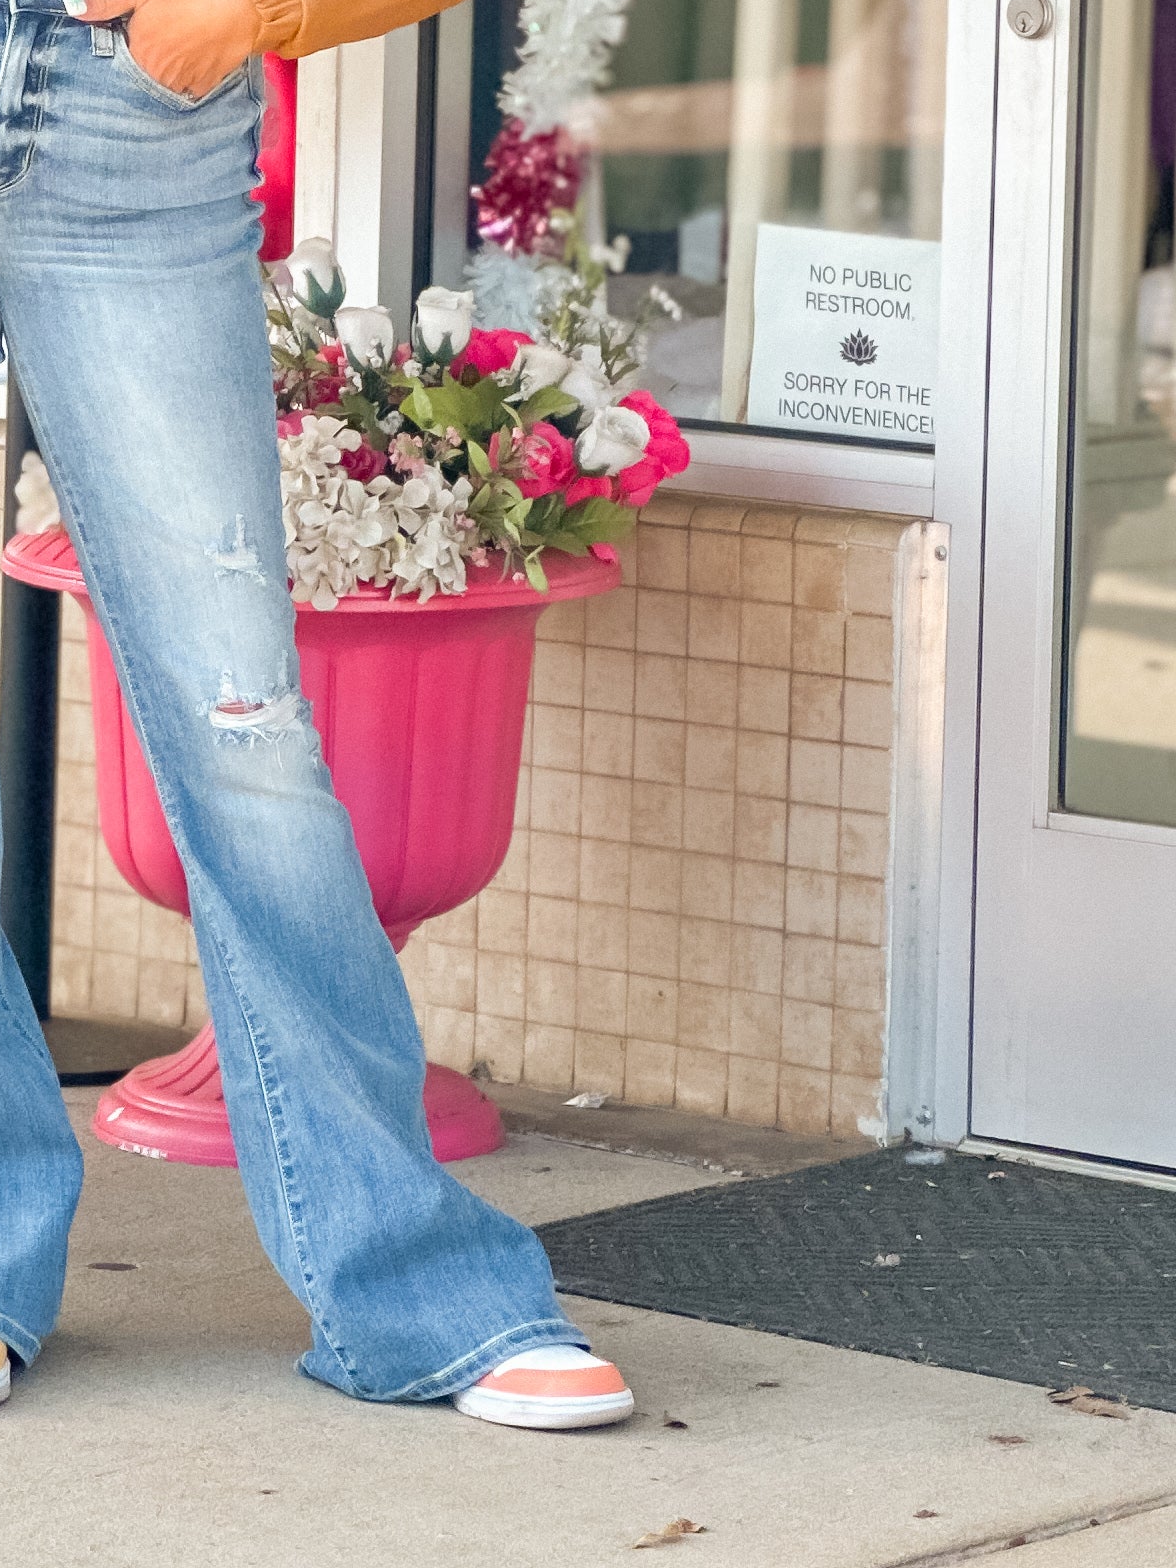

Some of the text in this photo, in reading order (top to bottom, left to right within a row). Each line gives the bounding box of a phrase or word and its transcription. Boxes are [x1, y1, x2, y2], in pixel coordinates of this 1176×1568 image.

[809, 264, 912, 292] NO PUBLIC
[805, 291, 916, 321] RESTROOM.
[784, 371, 931, 407] SORRY FOR THE
